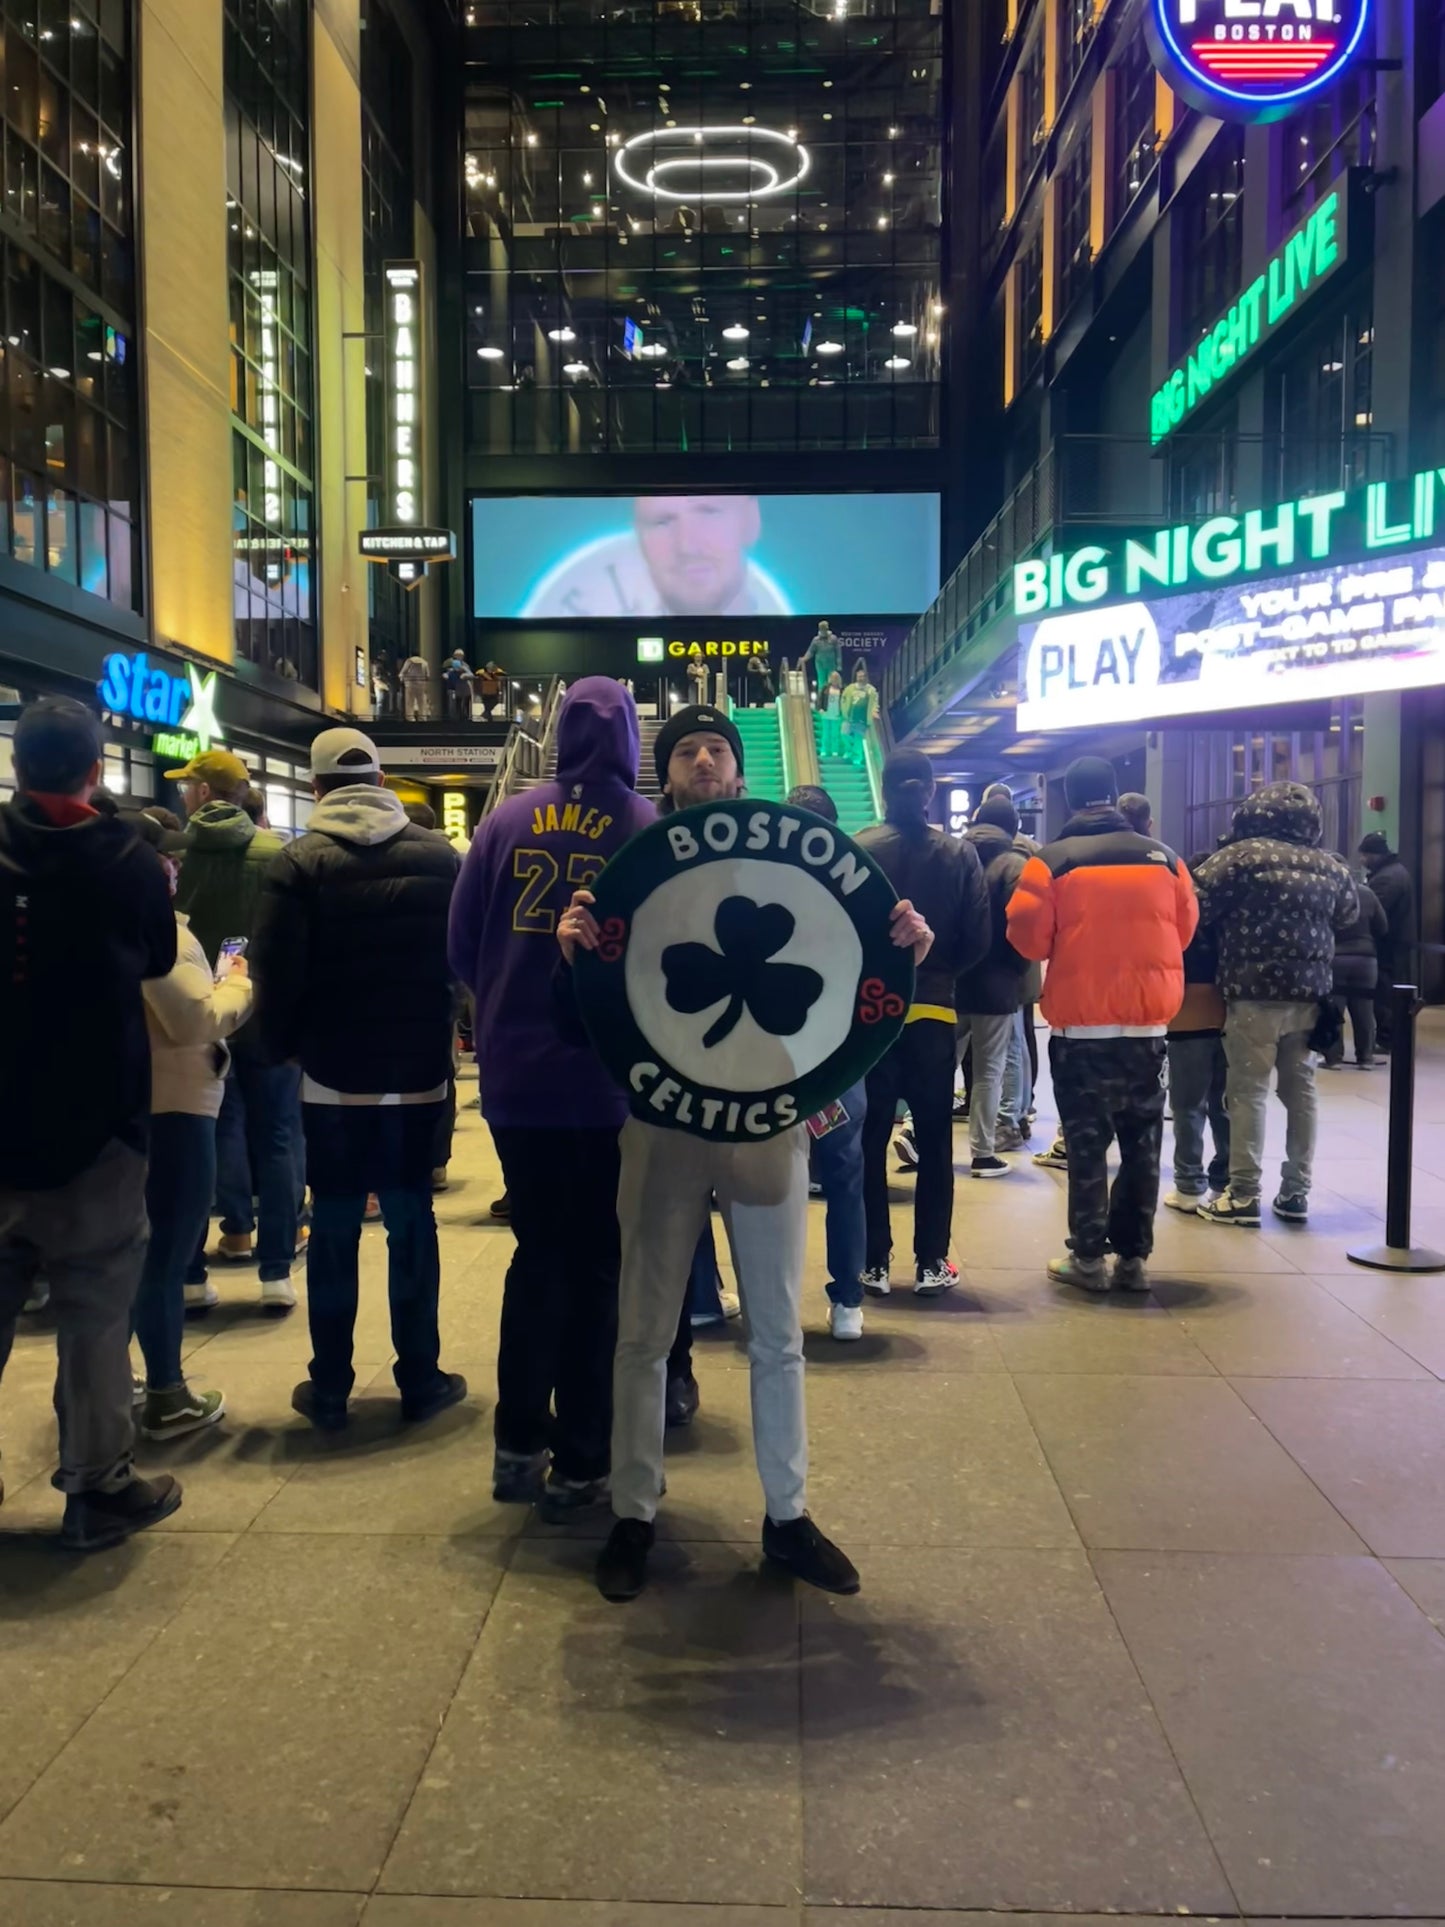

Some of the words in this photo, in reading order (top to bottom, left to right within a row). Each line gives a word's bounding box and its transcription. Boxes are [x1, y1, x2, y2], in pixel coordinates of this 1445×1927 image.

[1214, 24, 1312, 41] BOSTON
[1187, 274, 1265, 409] NIGHT
[1268, 191, 1338, 325] LIVE
[362, 536, 413, 549] KITCHEN
[424, 536, 447, 549] TAP
[1014, 545, 1110, 616] BIG
[1125, 491, 1346, 594] NIGHT
[1240, 582, 1332, 618] YOUR
[668, 640, 769, 656] GARDEN
[839, 637, 887, 647] SOCIETY
[1040, 628, 1146, 698] PLAY
[153, 732, 199, 760] market
[420, 748, 454, 756] NORTH
[457, 748, 496, 756] STATION
[531, 803, 613, 839] JAMES
[667, 811, 871, 896] BOSTON
[629, 1062, 798, 1134] CELTICS
